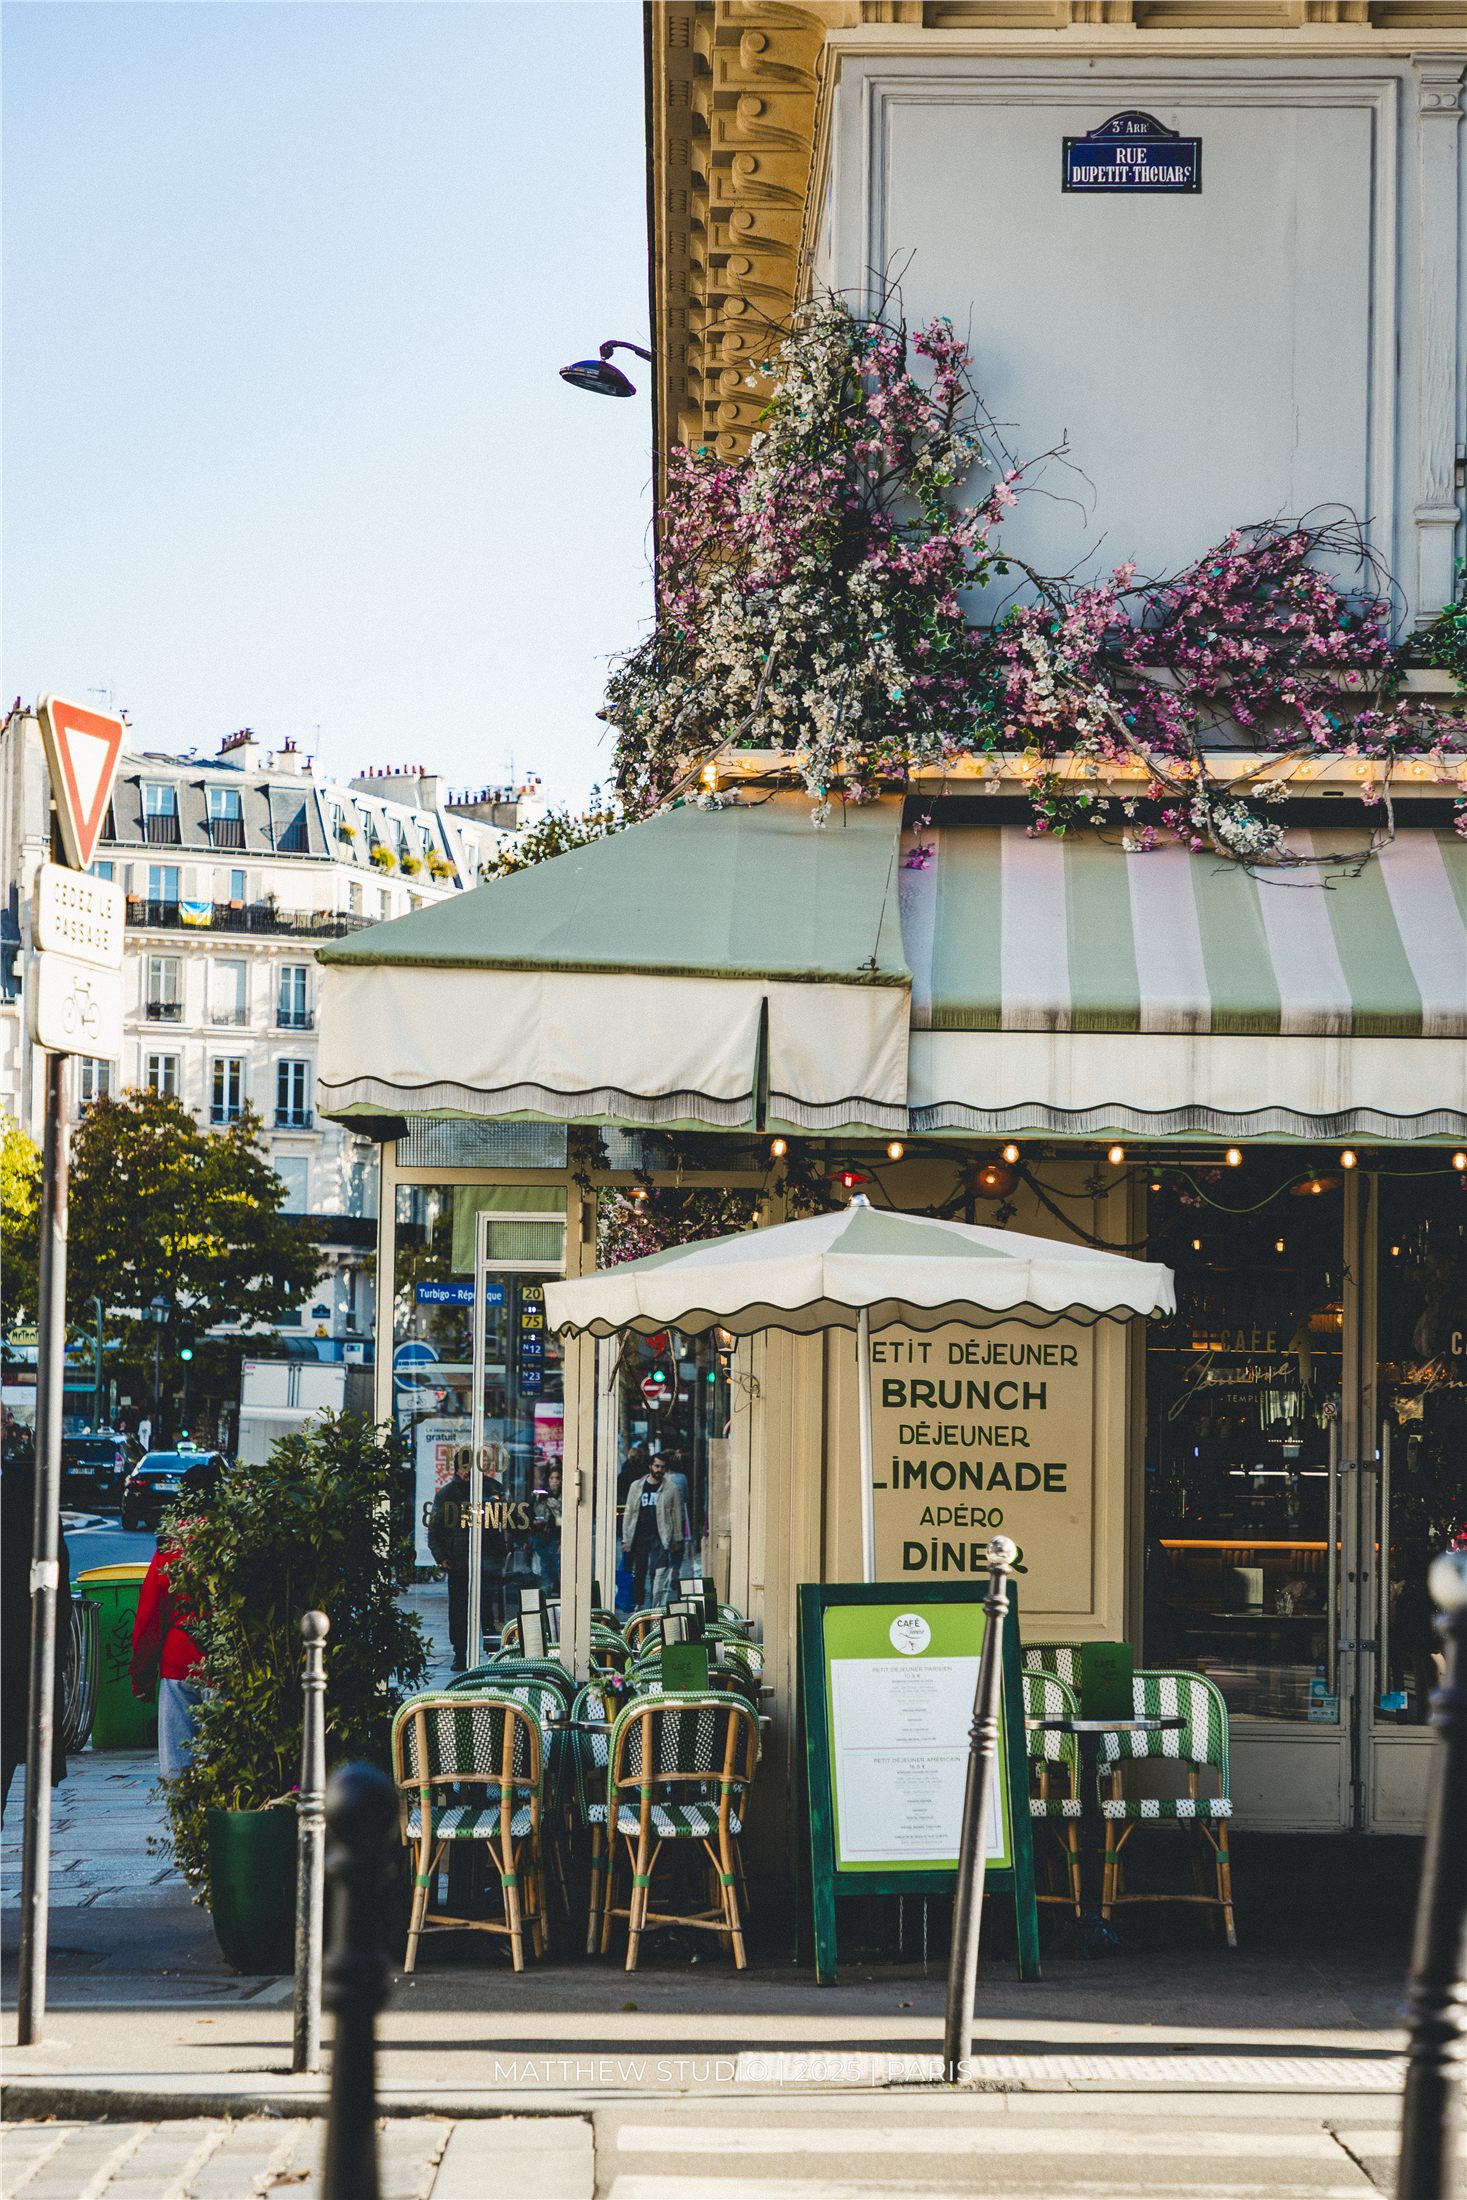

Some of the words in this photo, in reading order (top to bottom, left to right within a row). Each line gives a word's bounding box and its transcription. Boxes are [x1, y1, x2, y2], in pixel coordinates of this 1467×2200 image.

[1116, 147, 1147, 164] RUE
[419, 1288, 450, 1301] Turbigo
[457, 1289, 502, 1302] Répque
[525, 1288, 541, 1299] 20
[525, 1316, 540, 1327] 75
[856, 1339, 932, 1363] ETIT
[948, 1339, 1078, 1366] DÉJEUNER
[881, 1378, 1048, 1410] BRUNCH
[425, 1433, 457, 1443] gratuit
[899, 1421, 1030, 1448] DÉJEUNER
[443, 1501, 531, 1530] DRINKS
[919, 1503, 1004, 1528] APÉRO
[896, 1617, 920, 1628] CAFÉ
